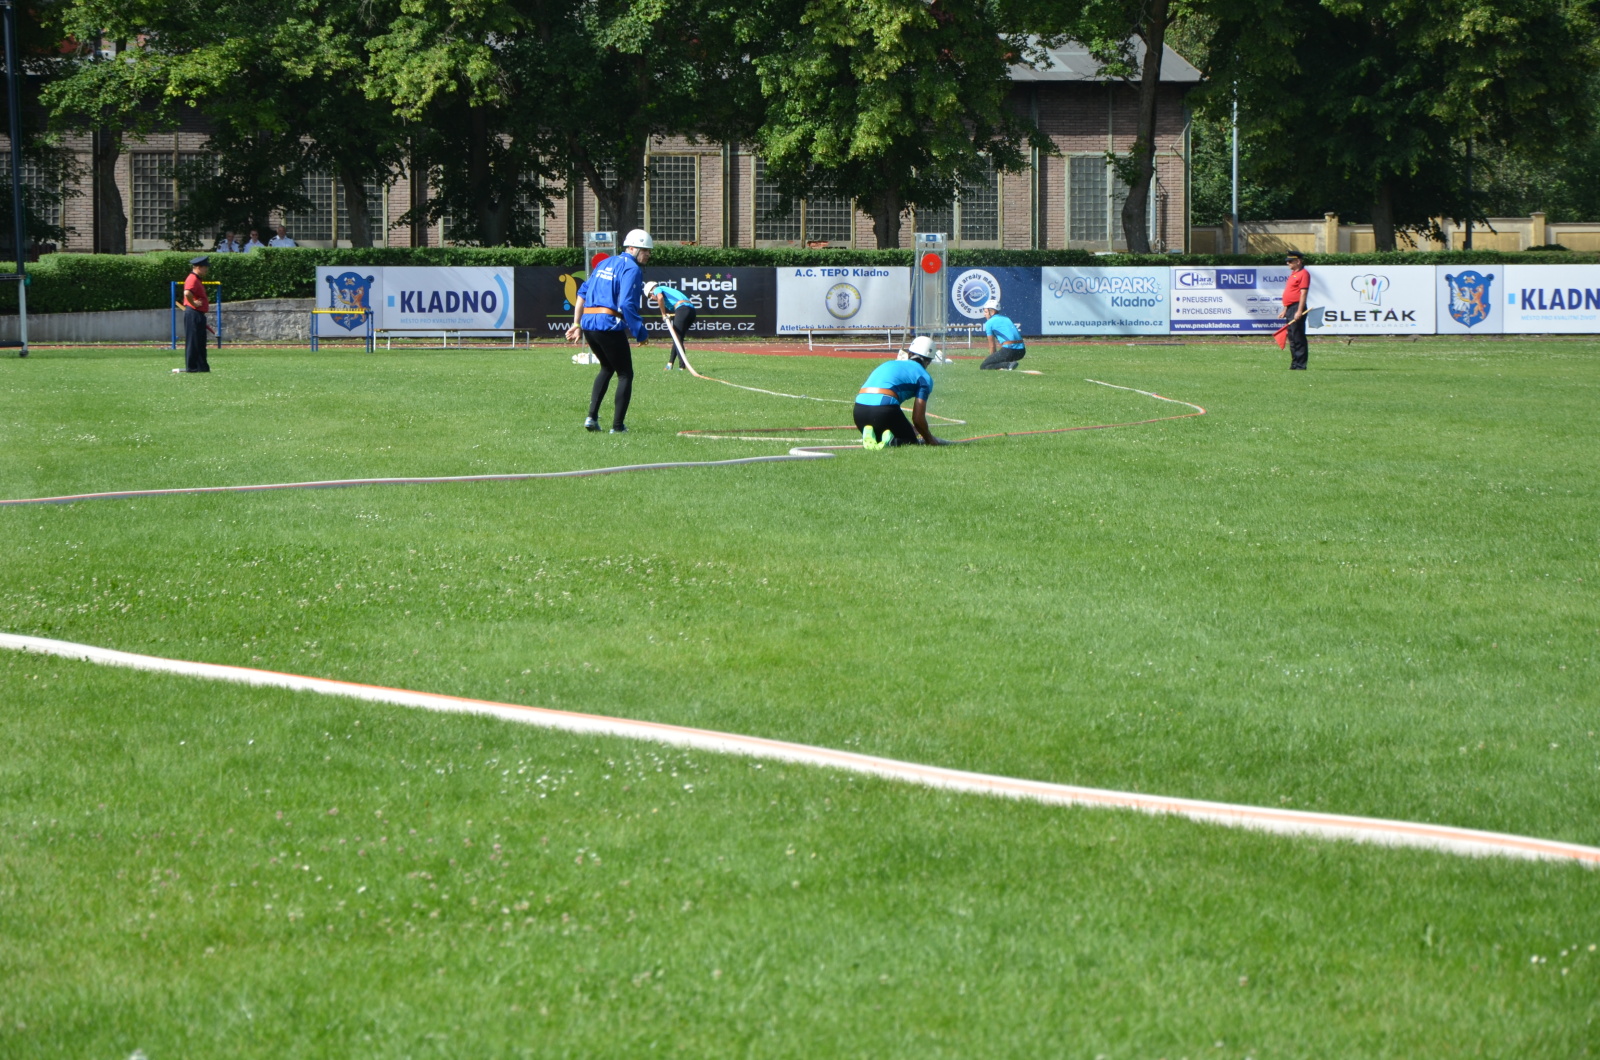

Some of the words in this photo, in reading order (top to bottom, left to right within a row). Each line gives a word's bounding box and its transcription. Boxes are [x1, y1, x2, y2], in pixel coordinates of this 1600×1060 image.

[795, 268, 816, 278] A.C.
[821, 268, 849, 278] TEPO
[853, 268, 889, 278] Kladno
[681, 277, 737, 291] Hotel
[1220, 273, 1254, 285] PNEU
[1262, 275, 1290, 283] KLADN
[1060, 276, 1156, 294] AQUAPARK
[400, 290, 497, 313] KLADNO
[1111, 296, 1156, 307] Kladno
[1521, 288, 1600, 310] KLADN
[1182, 307, 1232, 315] RYCHLOSERVIS
[1048, 319, 1163, 327] www.aquapark-kladno.cz
[1174, 322, 1240, 330] www.pneukladno.cz
